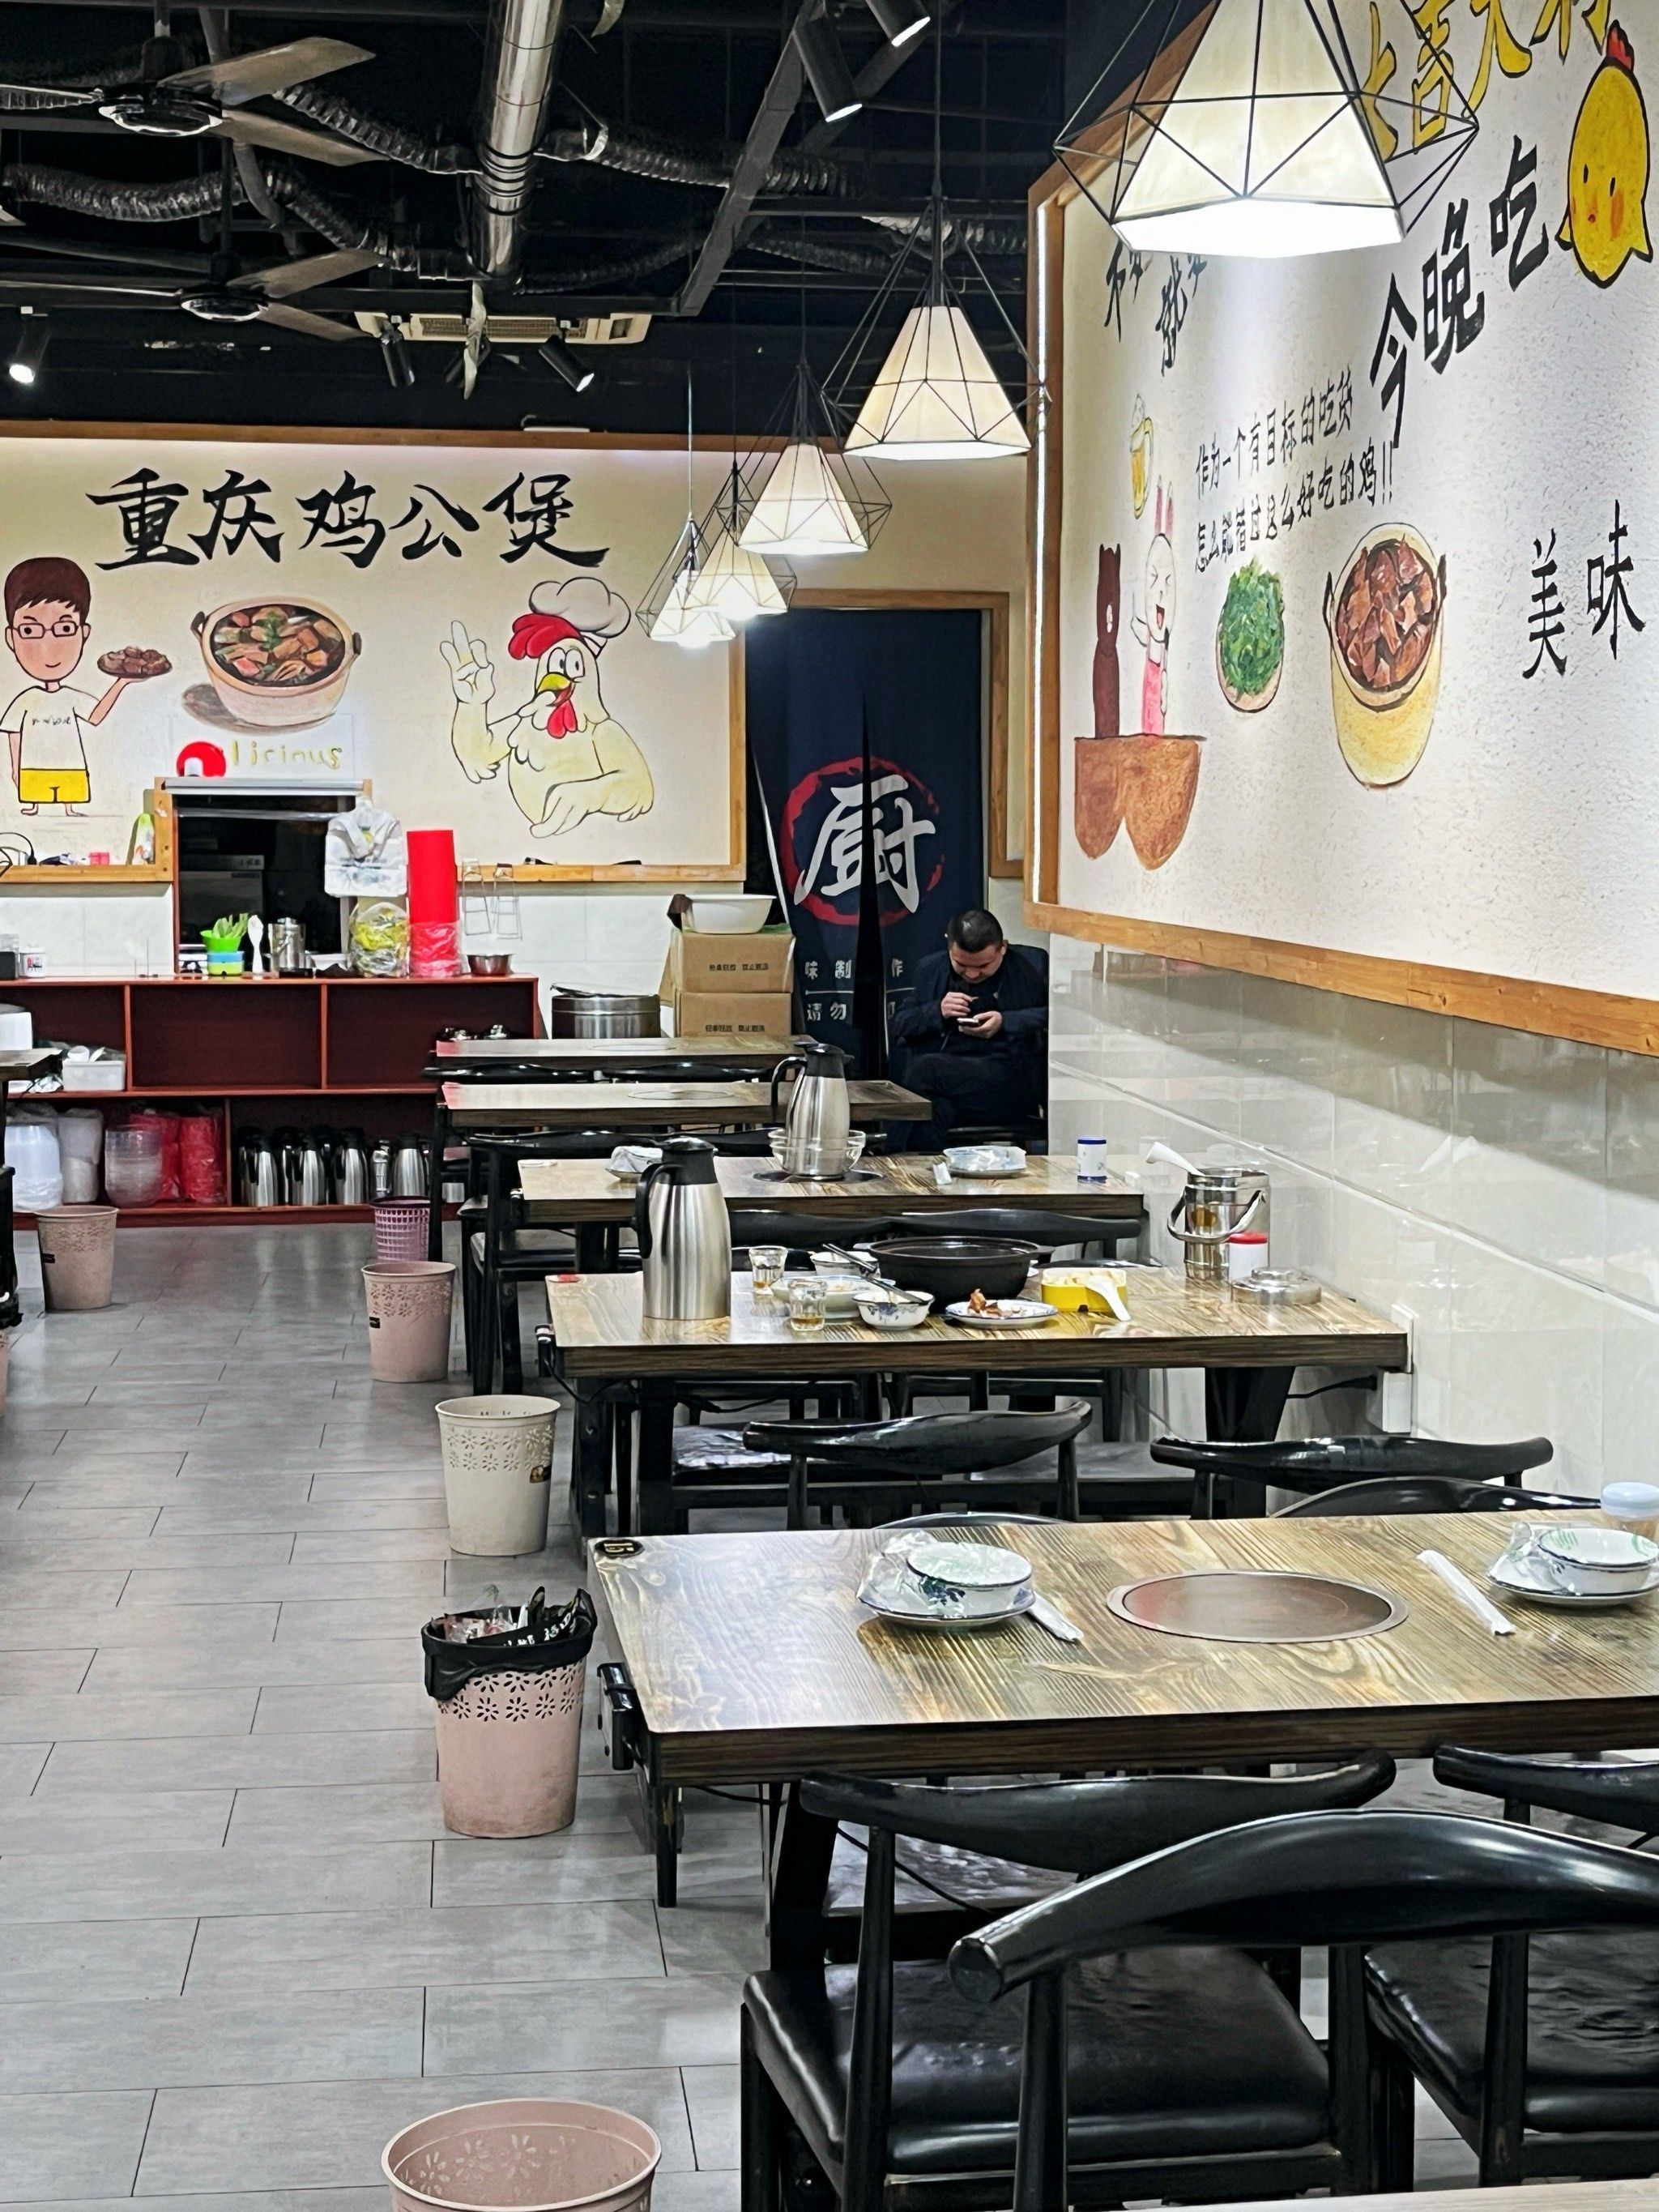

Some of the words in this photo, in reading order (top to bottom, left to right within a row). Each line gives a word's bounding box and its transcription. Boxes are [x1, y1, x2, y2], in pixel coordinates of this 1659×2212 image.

[1370, 135, 1550, 449] 今晚吃
[85, 468, 611, 570] 重庆鸡公煲
[1522, 499, 1647, 680] 美味
[794, 775, 936, 914] 厨
